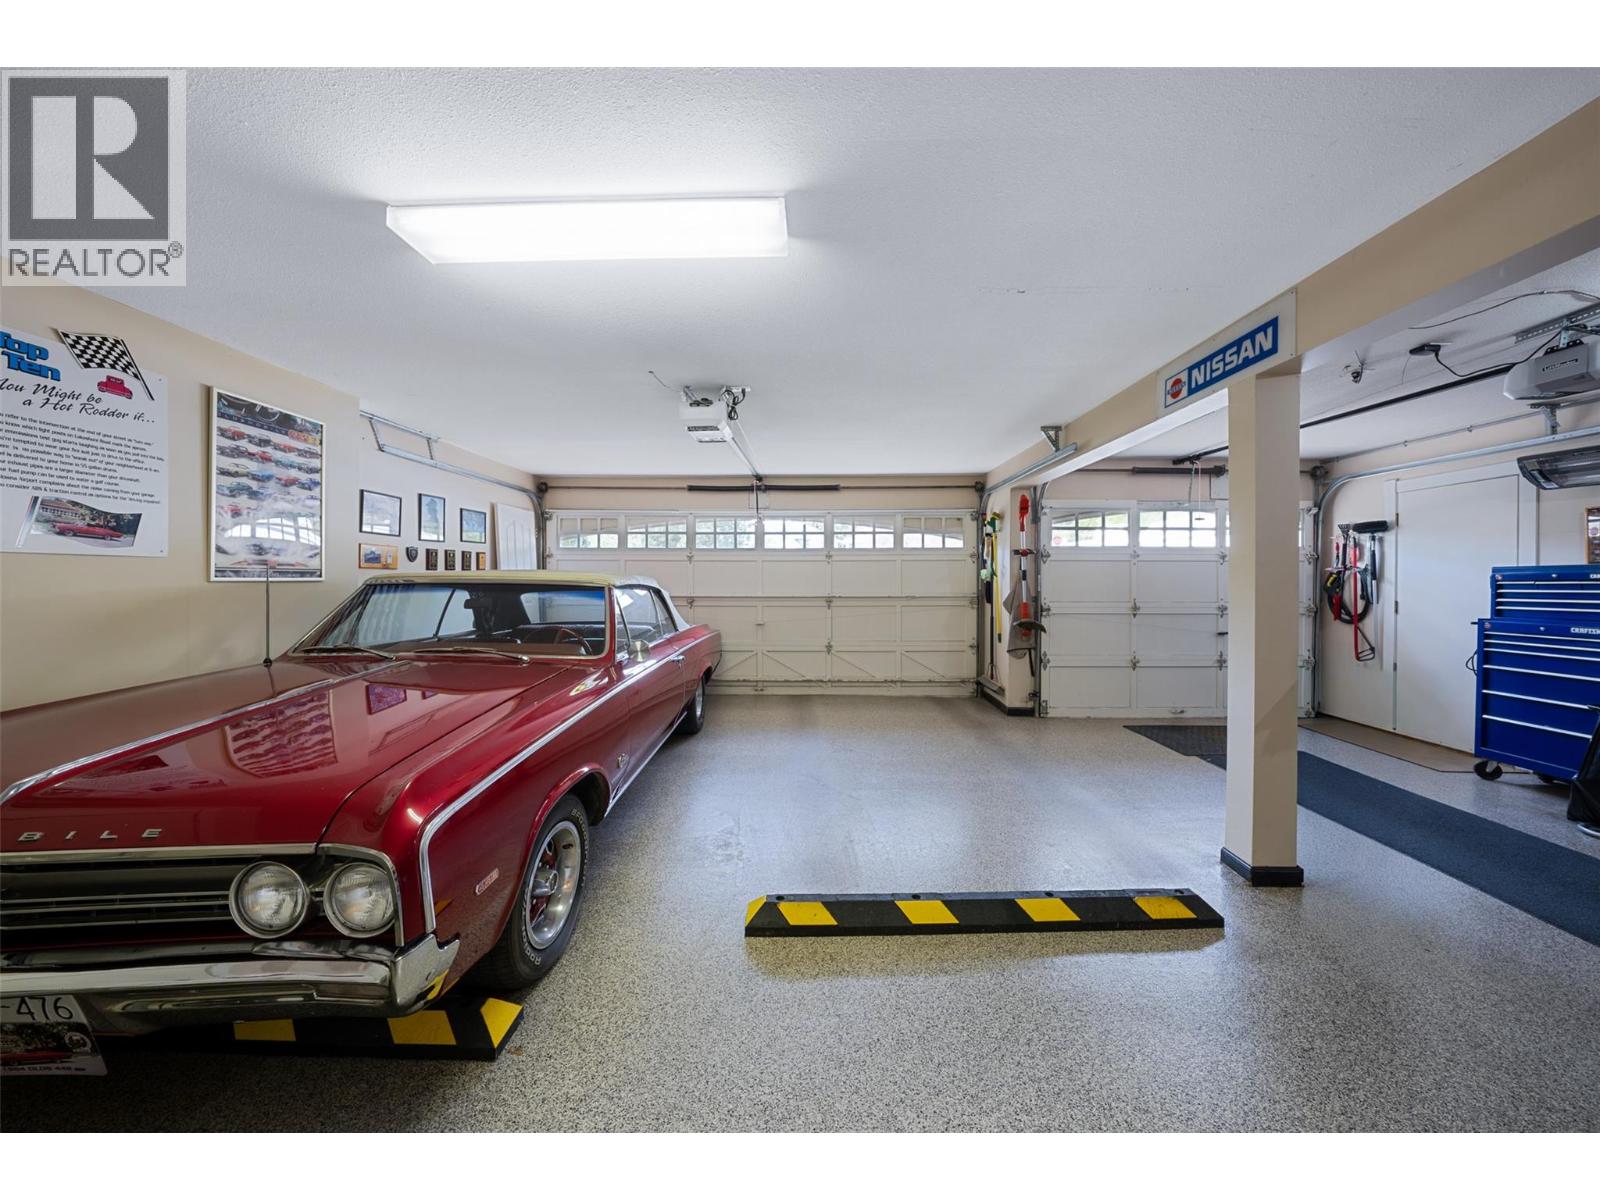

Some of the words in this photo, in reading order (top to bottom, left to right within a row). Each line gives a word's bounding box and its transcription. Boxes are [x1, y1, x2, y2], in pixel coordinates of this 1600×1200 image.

[2, 351, 61, 382] Ten
[1191, 326, 1273, 389] NISSAN
[32, 383, 81, 402] Might
[87, 394, 102, 404] be
[40, 397, 73, 412] Hot
[80, 403, 129, 419] Rodder
